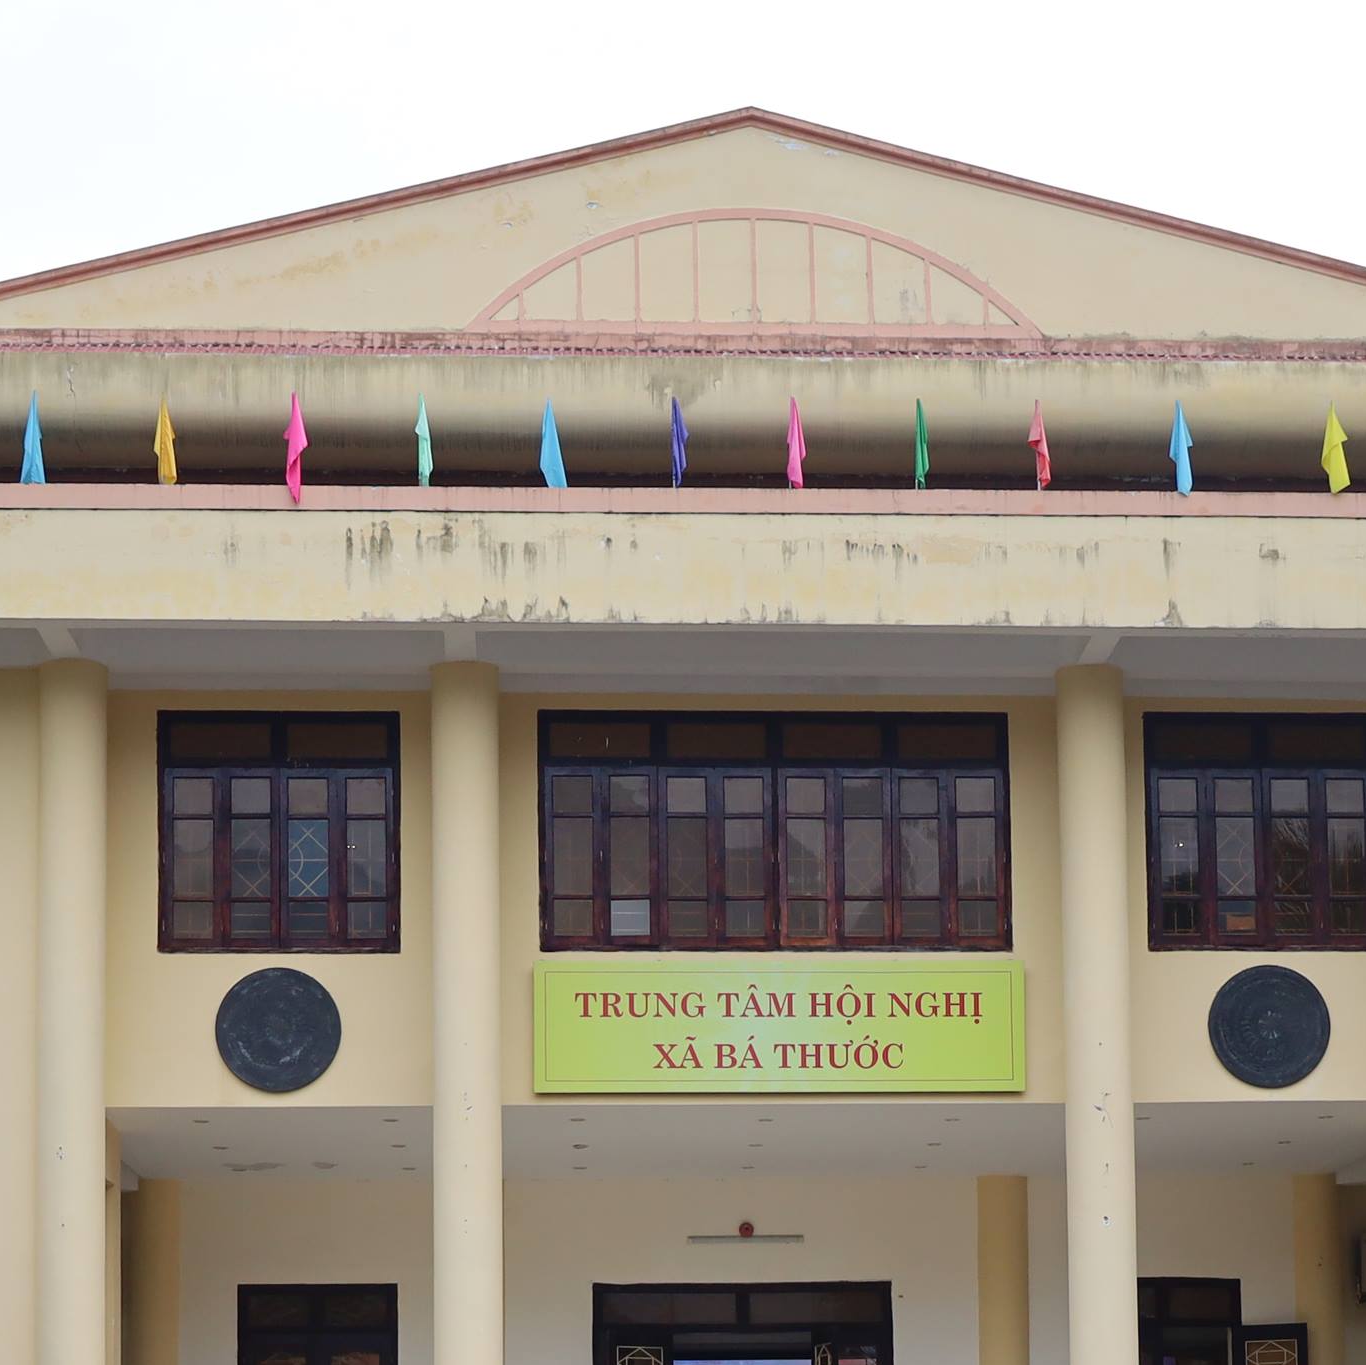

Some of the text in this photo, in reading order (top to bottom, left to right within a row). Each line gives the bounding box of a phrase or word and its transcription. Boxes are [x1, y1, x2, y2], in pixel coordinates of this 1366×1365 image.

[575, 984, 983, 1025] TRUNG TÂM HỘI NGHỊ
[653, 1035, 904, 1069] XÃ BÁ THƯỚC
